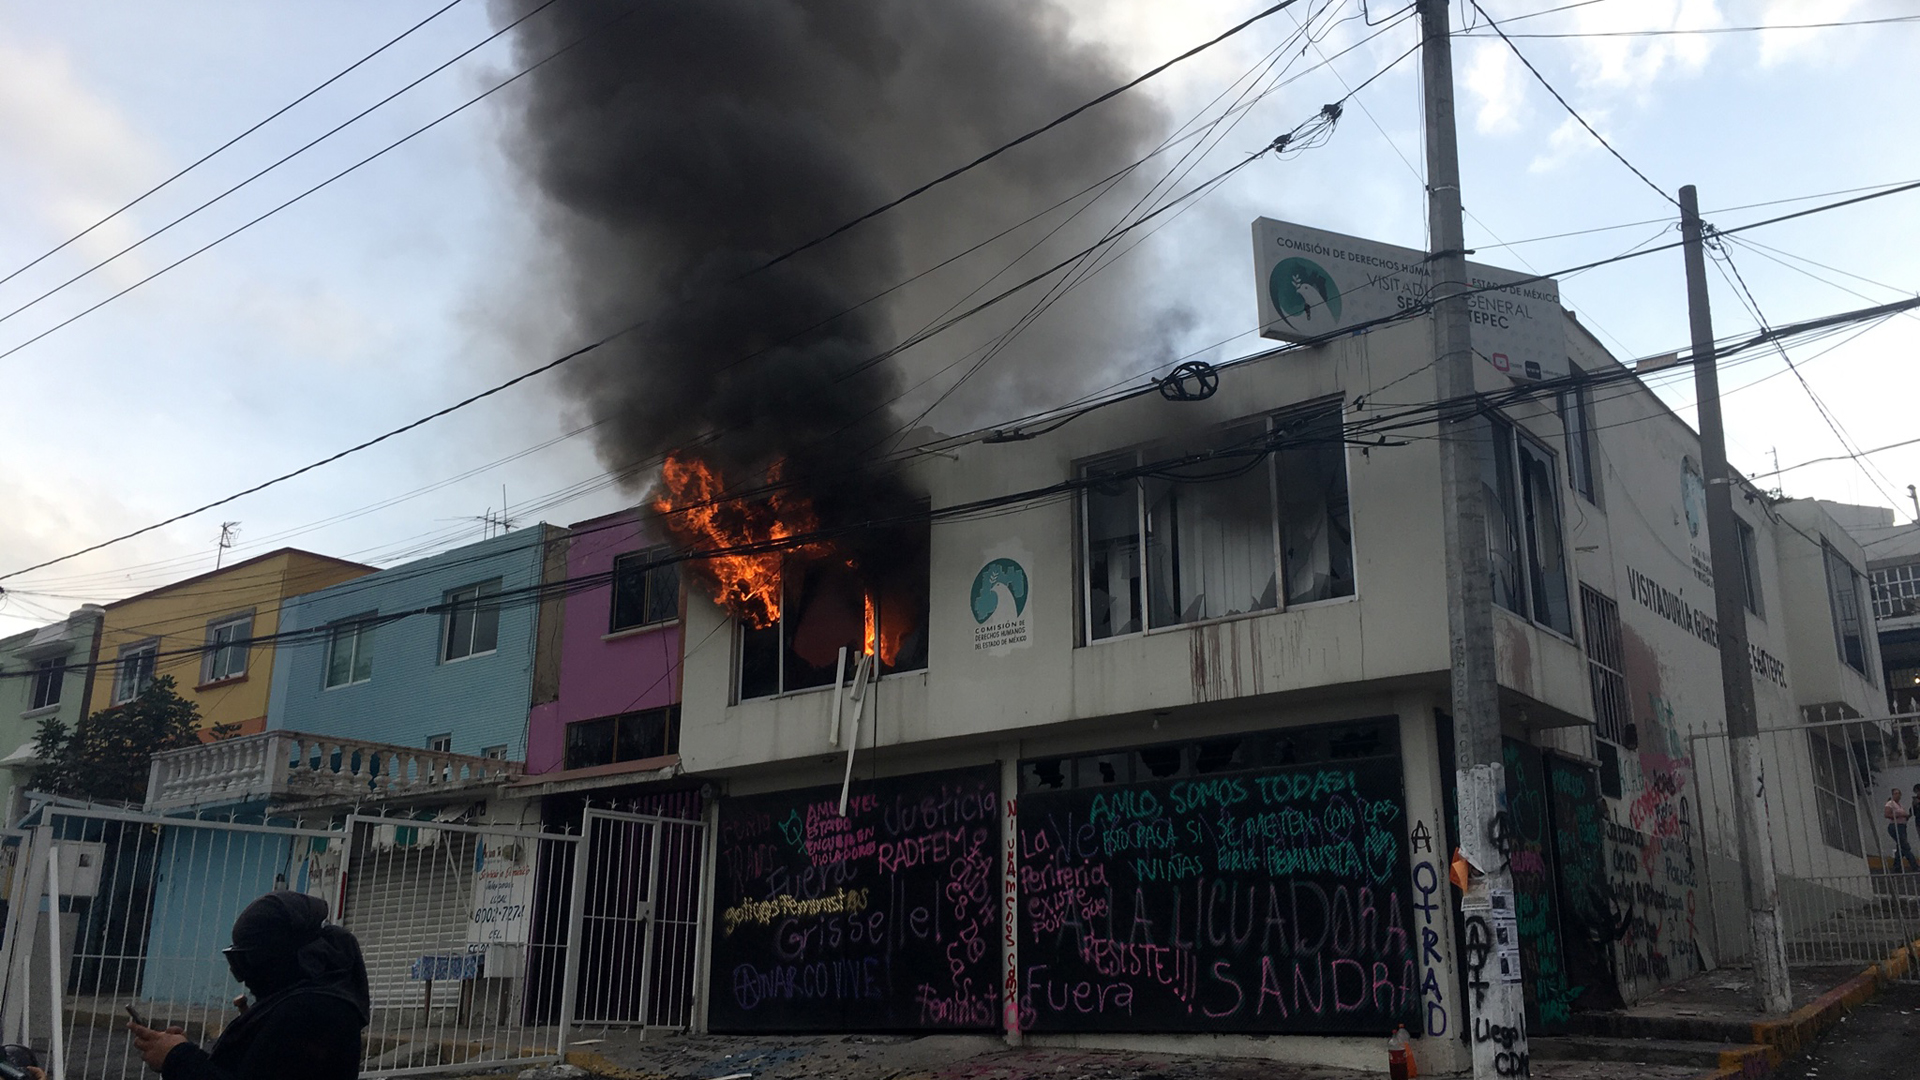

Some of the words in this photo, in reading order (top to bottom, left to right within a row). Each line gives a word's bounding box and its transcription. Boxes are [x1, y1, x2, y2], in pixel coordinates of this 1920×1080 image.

[1276, 236, 1330, 257] COMISIÓN
[1331, 249, 1346, 260] DE
[1348, 252, 1400, 271] DERECHOS
[1401, 261, 1431, 277] HUMA
[1472, 277, 1507, 293] ESTADO
[1509, 284, 1522, 297] DE
[1523, 284, 1560, 304] MÉXICO
[1469, 311, 1510, 330] TEPEC
[1626, 564, 1695, 636] VISITADURÍA
[975, 620, 1018, 635] COMISIÓN
[975, 630, 1000, 642] DERECHOS
[1000, 627, 1025, 637] HUMANOS
[982, 640, 1000, 649] ESTADO
[1008, 635, 1027, 643] MÉXICO
[884, 784, 998, 836] Justicia
[1170, 776, 1249, 815] SOMOS
[878, 825, 969, 876] RADFEM
[1136, 852, 1204, 882] NIÑAS
[1026, 964, 1133, 1017] Fuera
[1202, 952, 1419, 1018] SANDRA
